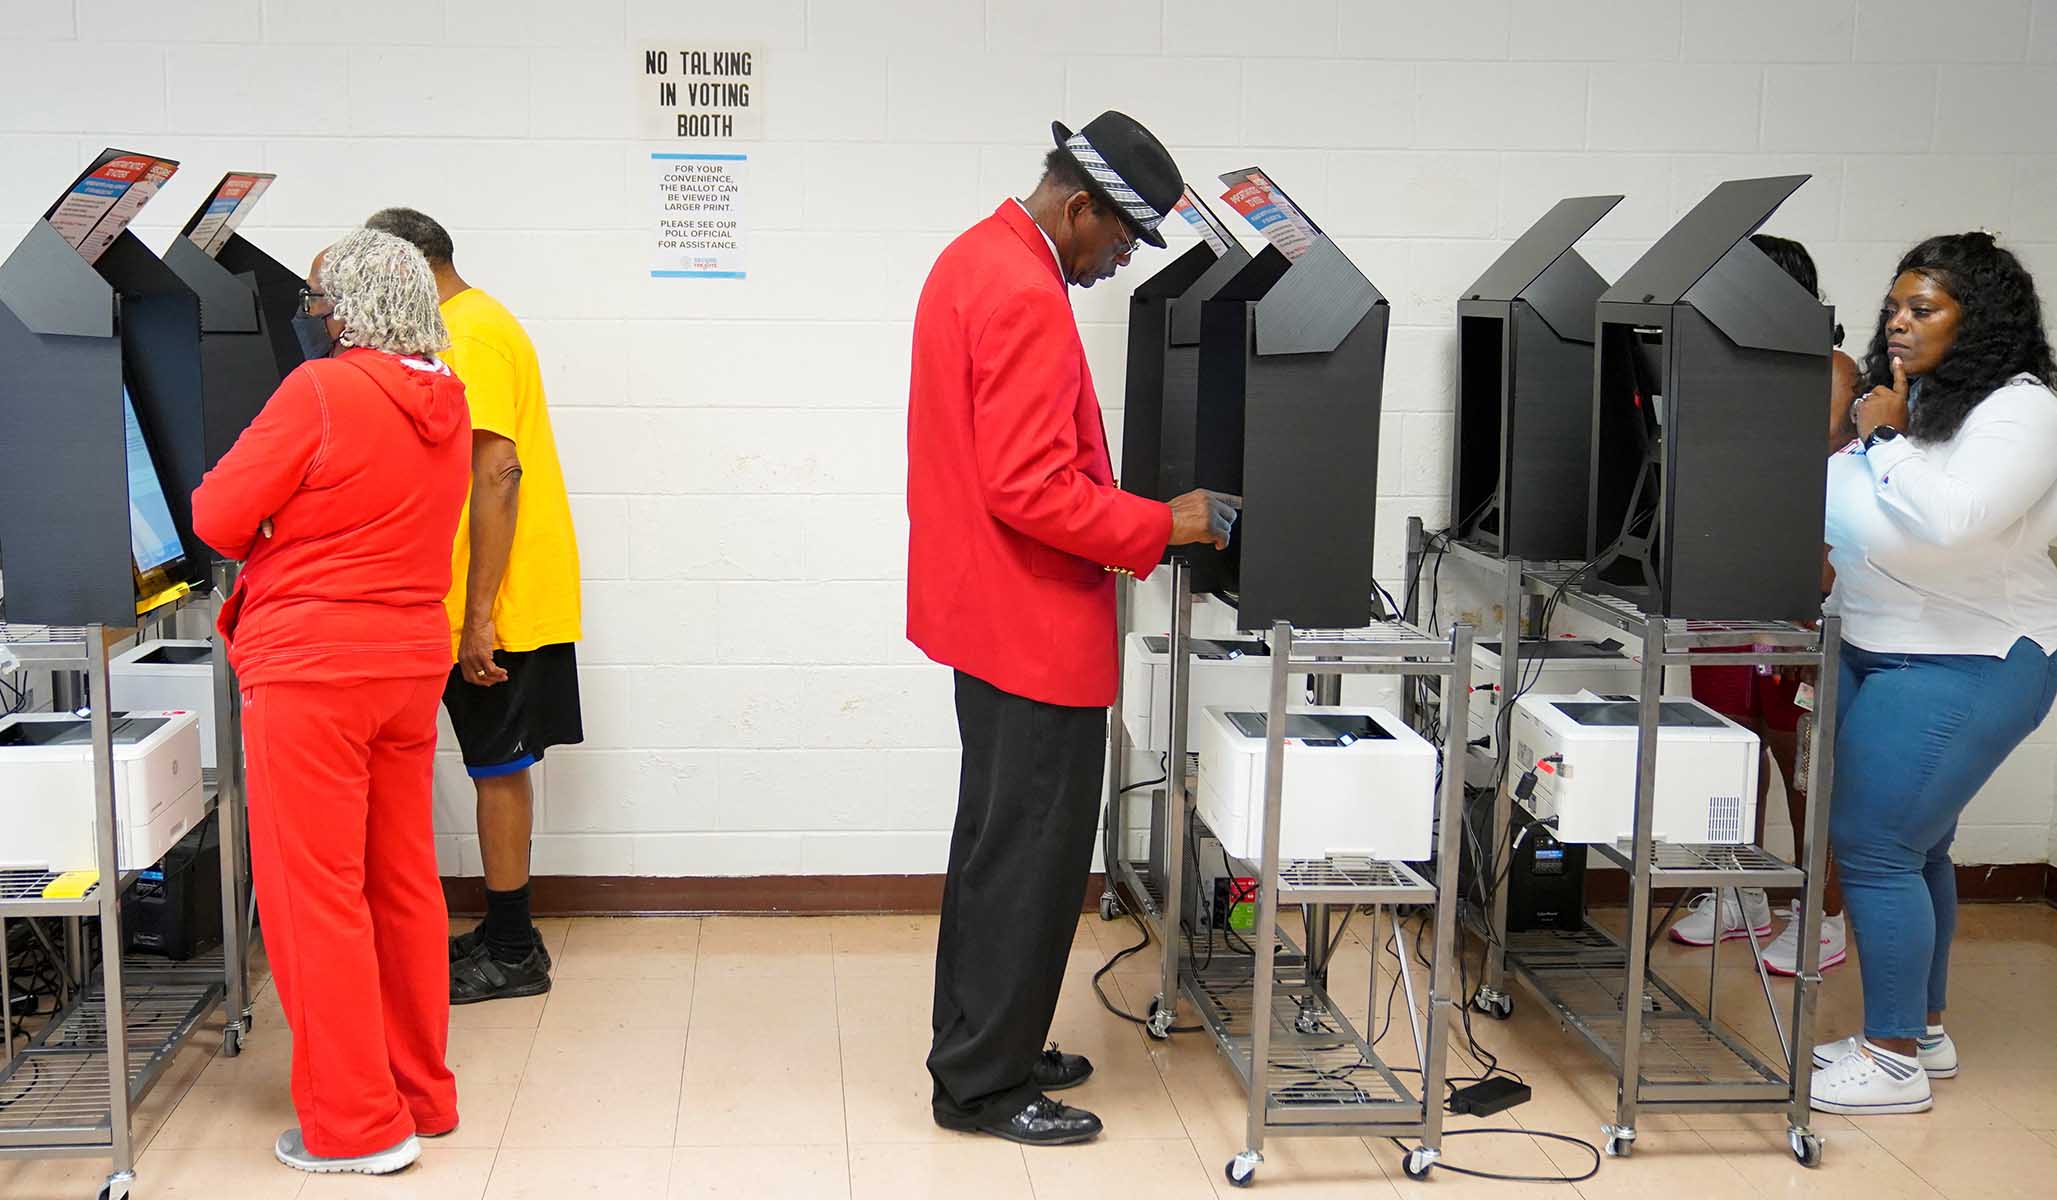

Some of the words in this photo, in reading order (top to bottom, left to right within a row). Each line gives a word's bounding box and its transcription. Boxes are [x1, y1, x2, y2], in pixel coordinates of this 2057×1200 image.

[646, 51, 667, 75] NO
[680, 51, 752, 76] TALKING
[660, 82, 677, 106] IN
[688, 83, 749, 107] VOTING
[677, 114, 733, 137] BOOTH
[675, 165, 694, 173] FOR
[697, 165, 723, 174] YOUR
[664, 174, 734, 184] CONVENIENCE,
[660, 184, 677, 192] THE
[680, 184, 715, 192] BALLOT
[718, 185, 738, 193] CAN
[667, 193, 680, 201] BE
[682, 193, 718, 202] VIEWED
[720, 194, 730, 202] IN
[664, 203, 701, 211] LARGER
[660, 220, 695, 228] PLEASE
[697, 220, 714, 229] SEE
[716, 221, 737, 229] OUR
[665, 229, 688, 237] POLL
[690, 230, 732, 238] OFFICIAL
[658, 240, 677, 248] FOR
